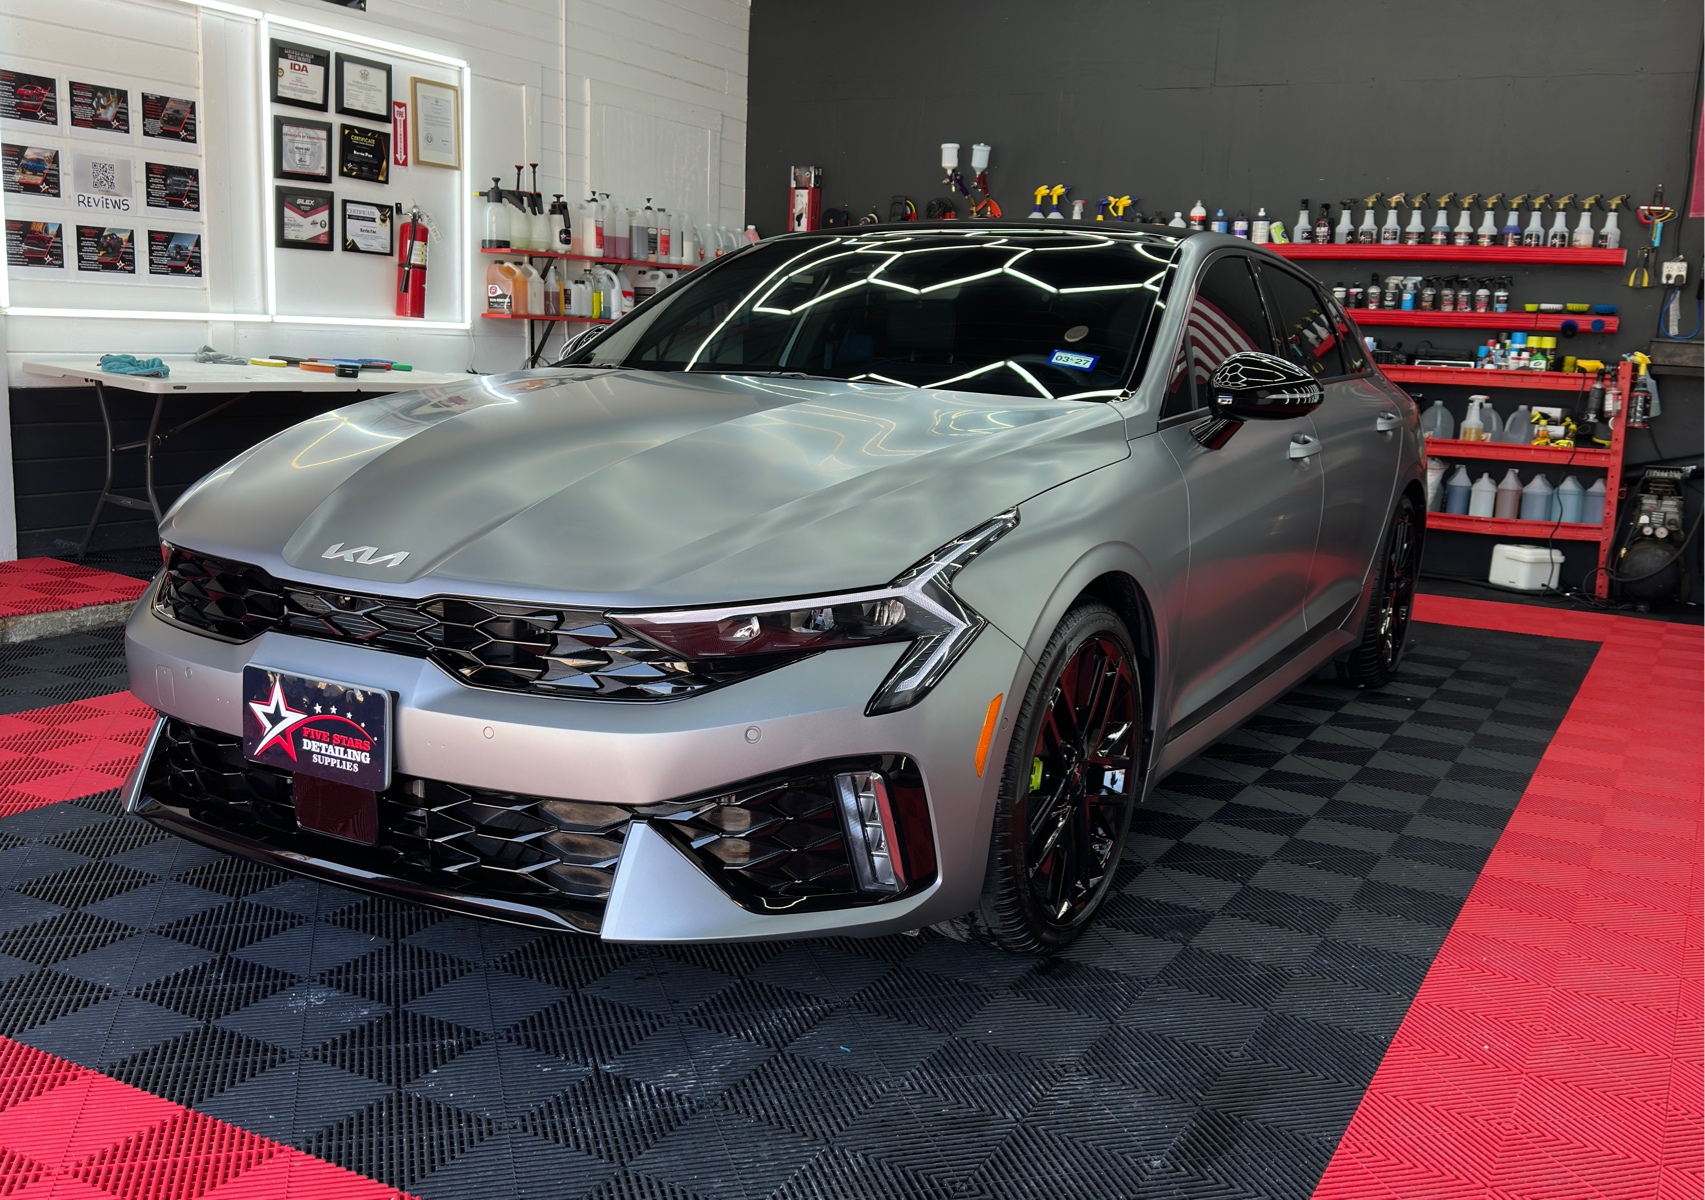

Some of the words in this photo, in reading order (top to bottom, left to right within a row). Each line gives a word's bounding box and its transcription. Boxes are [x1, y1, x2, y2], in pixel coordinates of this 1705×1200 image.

[290, 62, 309, 73] IDA
[321, 542, 410, 568] KIA
[302, 727, 330, 742] FIVE
[332, 733, 371, 751] STARS
[302, 738, 371, 764] DETAILING
[312, 754, 359, 772] SUPPLIES
